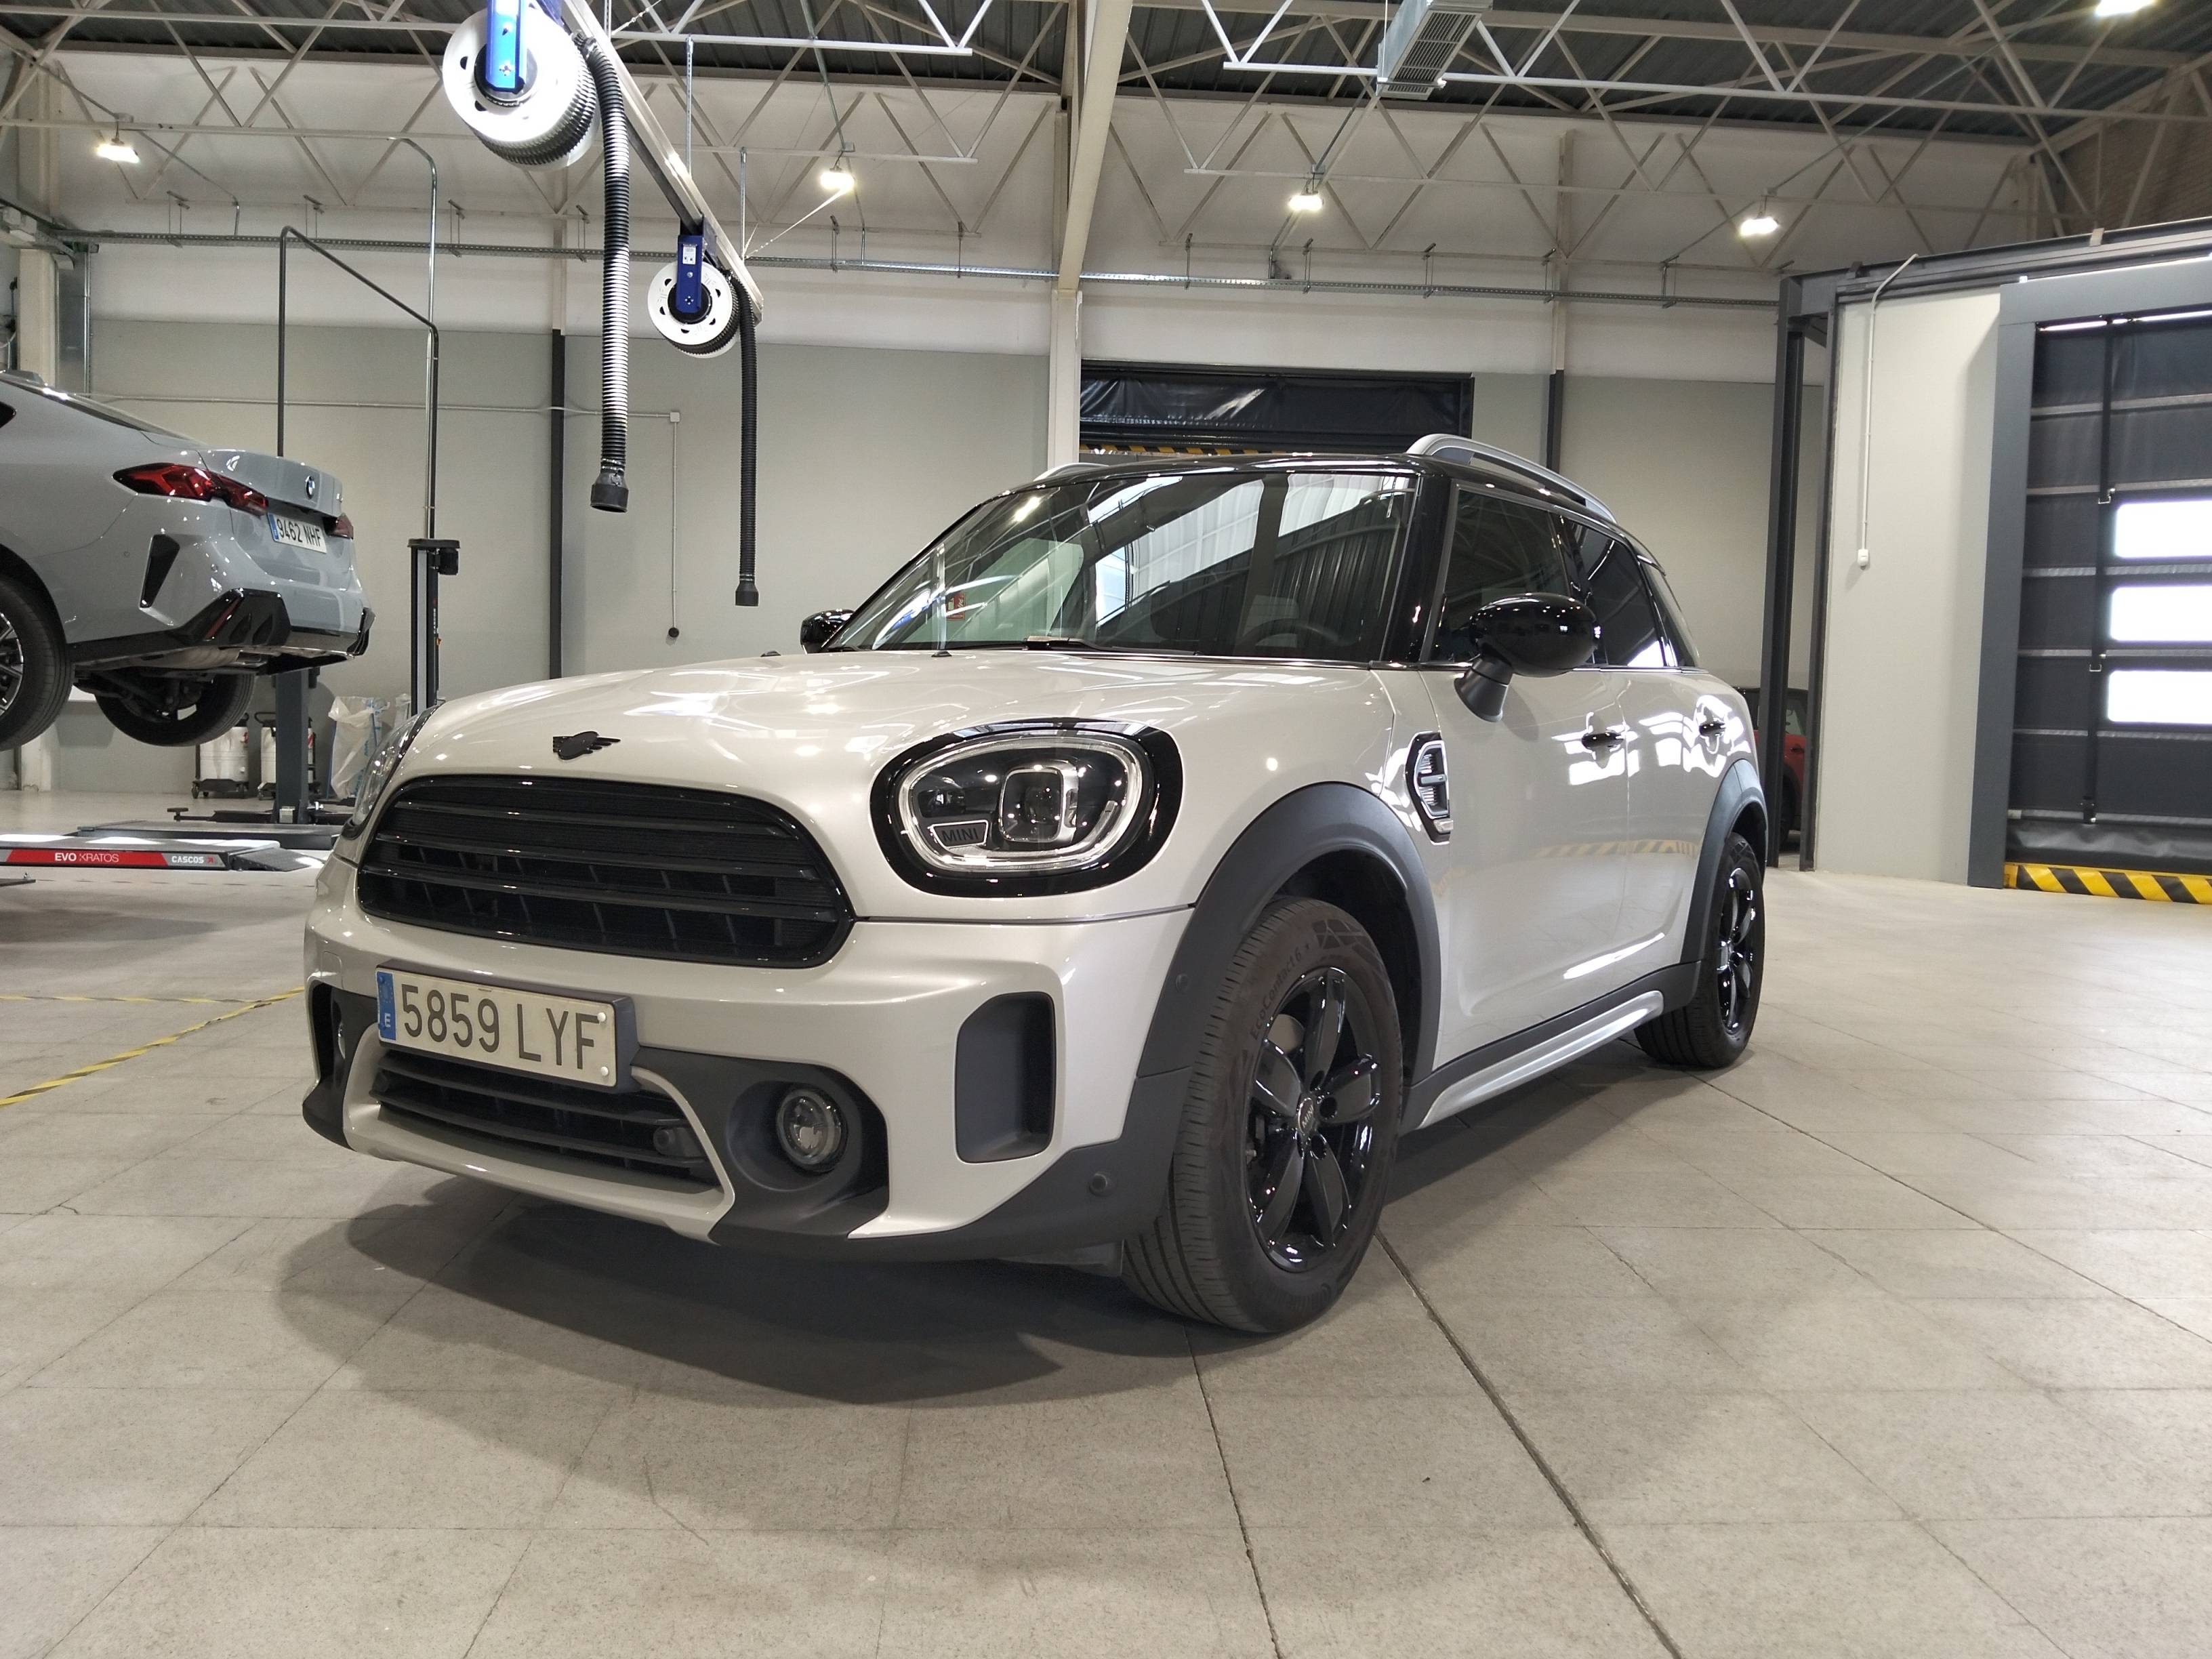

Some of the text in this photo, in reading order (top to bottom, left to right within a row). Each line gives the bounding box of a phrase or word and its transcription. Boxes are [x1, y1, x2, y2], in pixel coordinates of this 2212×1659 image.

[276, 518, 321, 547] 9462 NHF
[942, 827, 979, 842] MINI
[54, 853, 119, 863] EVO KRATOS
[171, 856, 204, 864] CASCOS
[384, 1012, 392, 1027] E
[401, 983, 600, 1070] 5859 LYF
[1302, 1105, 1314, 1128] MINI
